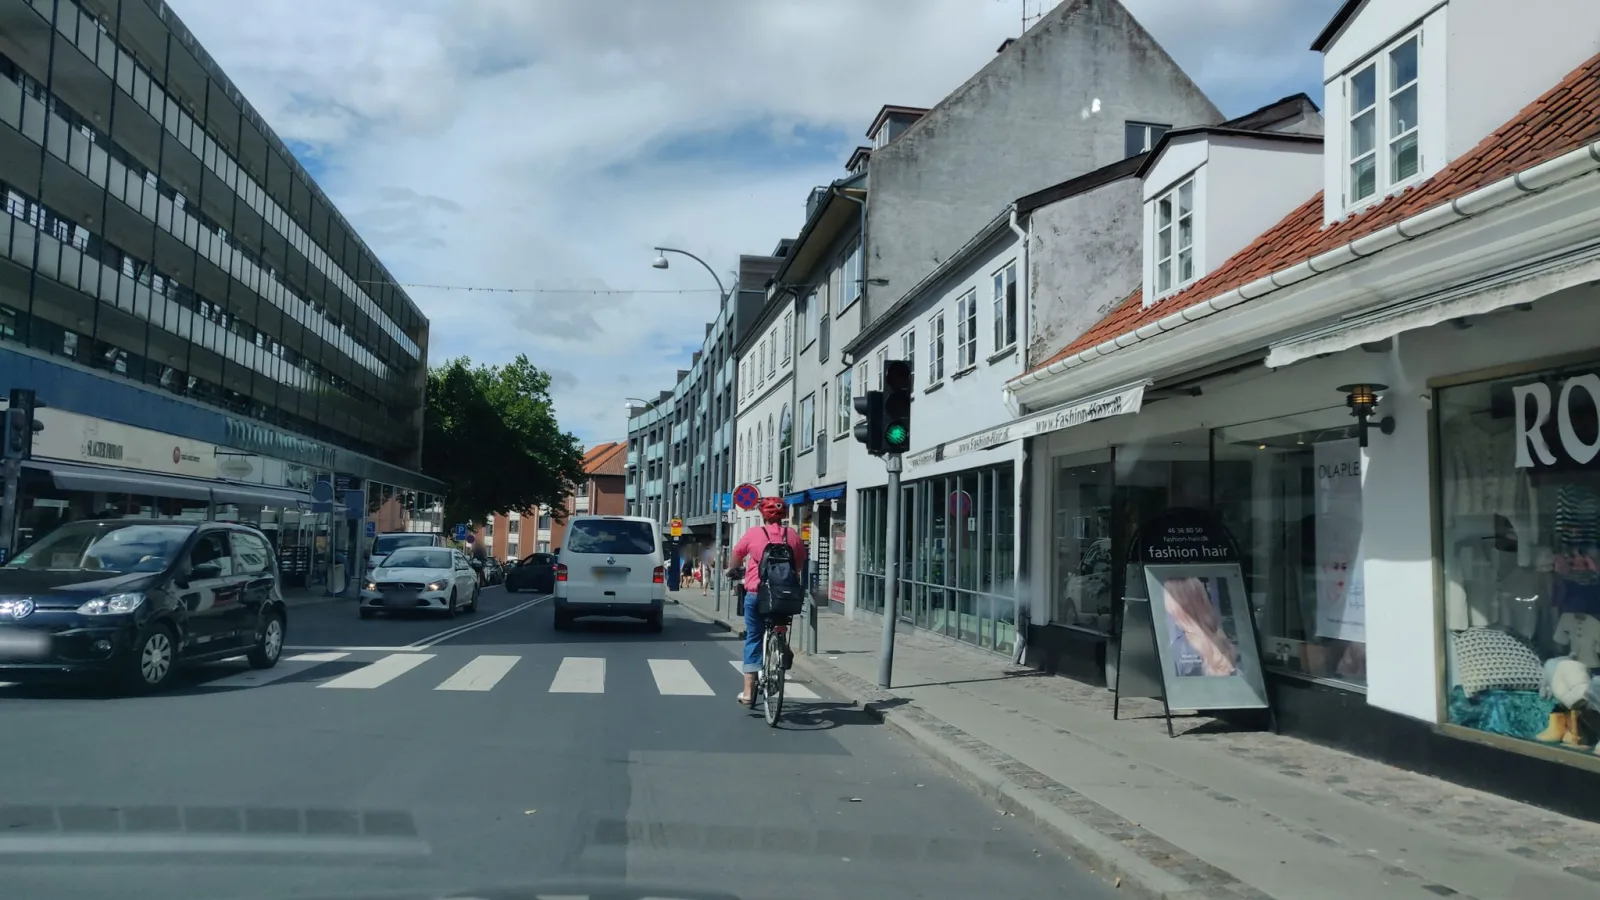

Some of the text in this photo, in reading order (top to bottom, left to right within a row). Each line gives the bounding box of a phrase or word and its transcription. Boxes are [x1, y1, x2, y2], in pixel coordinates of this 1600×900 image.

[1512, 373, 1600, 468] RO
[1318, 461, 1361, 479] OLAPLE
[1148, 544, 1228, 558] fashion hair
